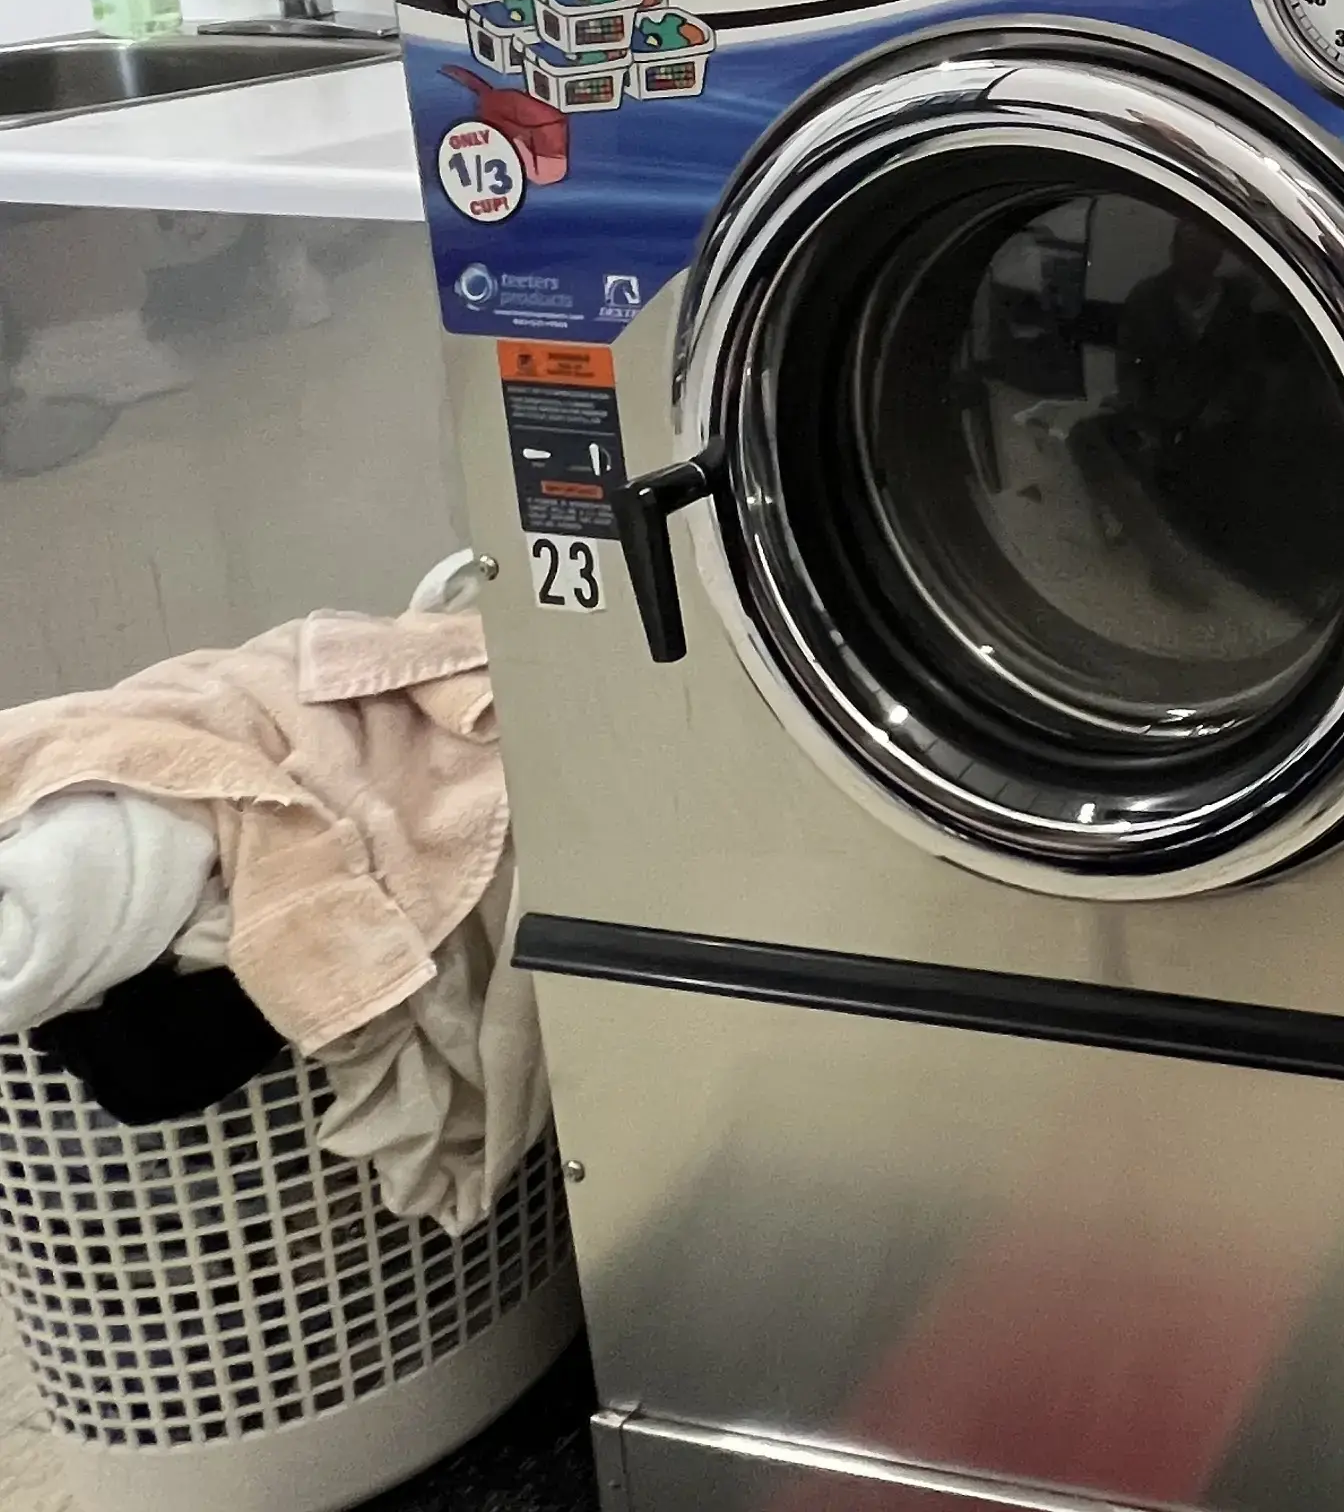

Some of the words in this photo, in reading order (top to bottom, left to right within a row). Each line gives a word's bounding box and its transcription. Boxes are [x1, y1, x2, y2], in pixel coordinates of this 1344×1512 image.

[449, 129, 491, 150] ONLY
[448, 152, 513, 195] 1/3
[469, 196, 510, 216] CUP!
[501, 273, 559, 290] teeters
[500, 291, 574, 308] products
[532, 538, 599, 609] 23
